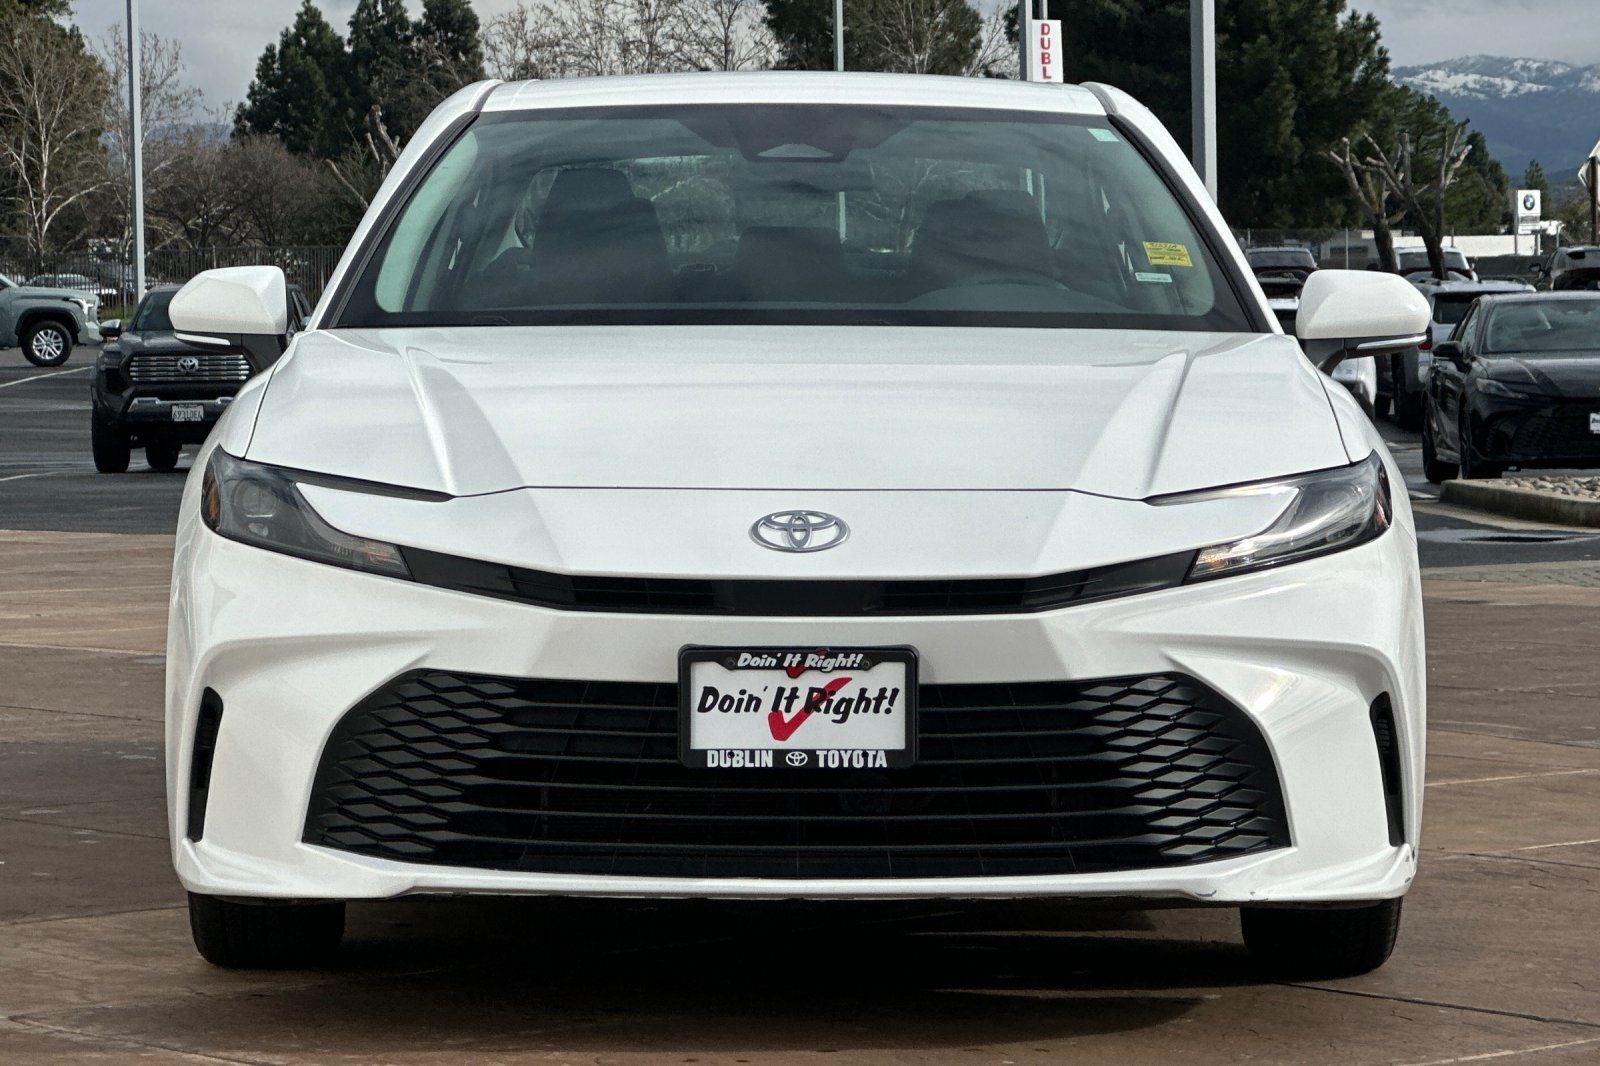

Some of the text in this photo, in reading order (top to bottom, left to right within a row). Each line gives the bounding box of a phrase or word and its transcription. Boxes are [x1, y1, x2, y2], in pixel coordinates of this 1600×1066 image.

[1040, 23, 1052, 80] DUBL
[737, 652, 864, 673] Doin' It Right!
[697, 685, 900, 724] Doin' It Right!
[706, 749, 888, 768] DUBLIN TOYOTA
